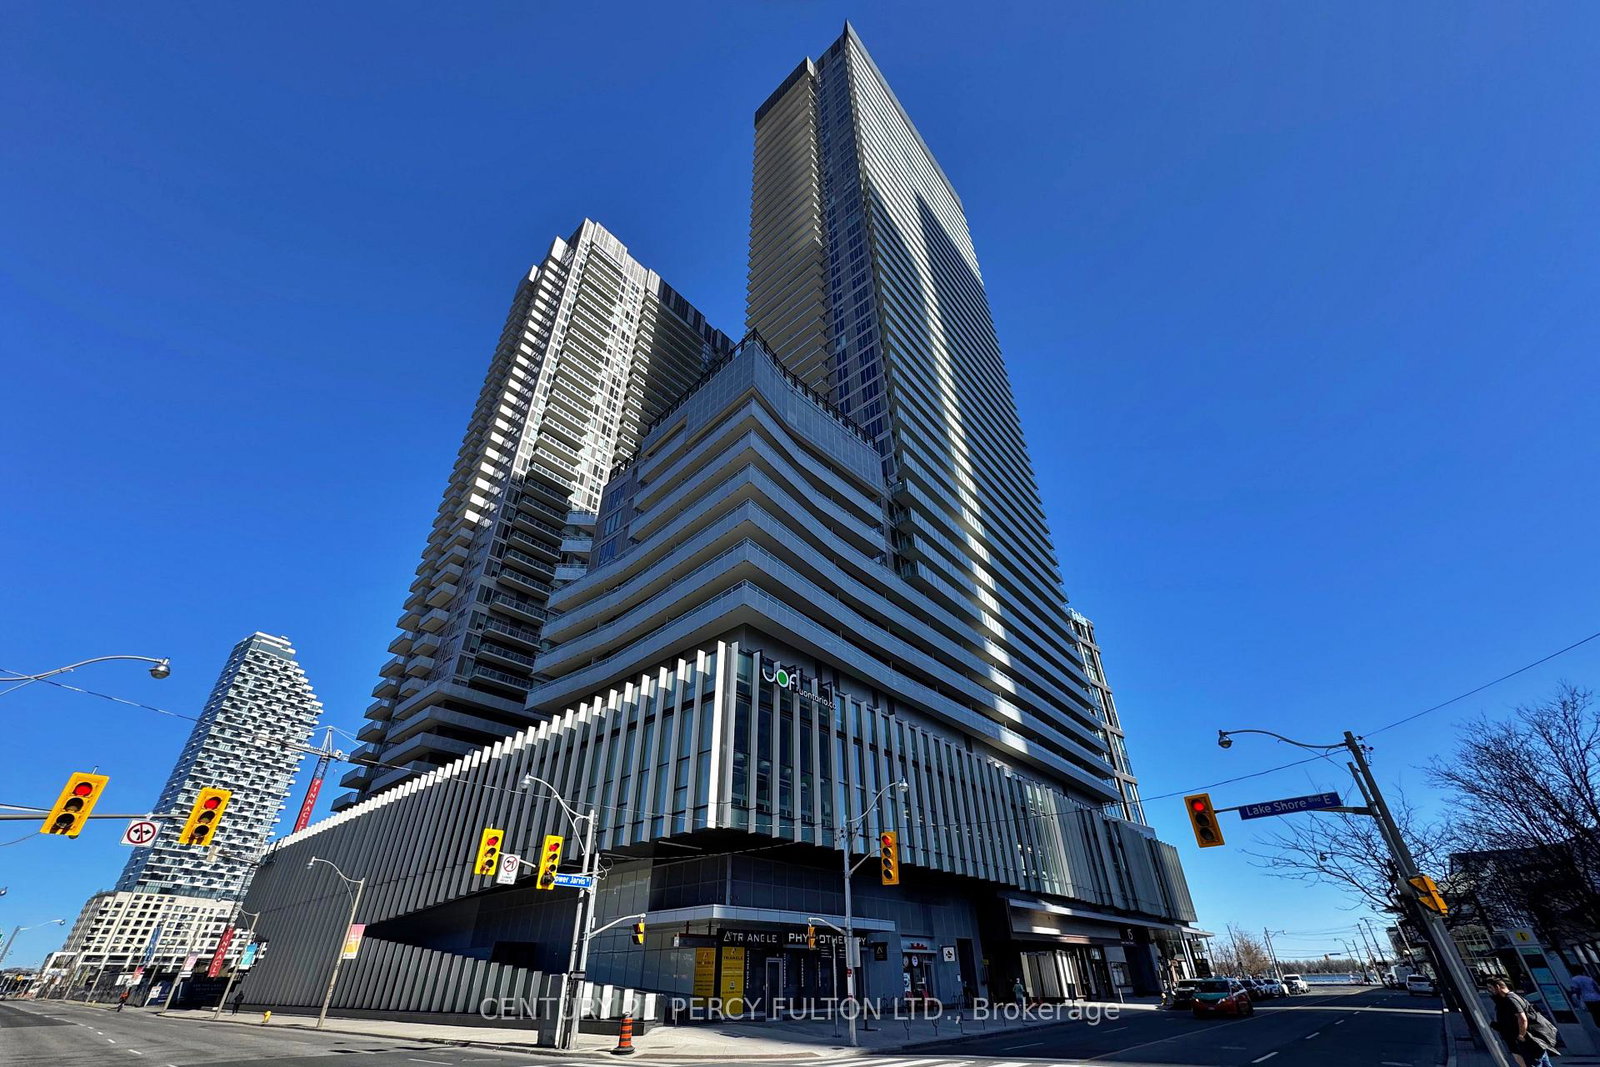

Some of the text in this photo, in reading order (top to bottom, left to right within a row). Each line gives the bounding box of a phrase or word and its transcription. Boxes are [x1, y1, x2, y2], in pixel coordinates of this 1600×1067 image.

[1246, 804, 1272, 816] Lake
[1273, 800, 1306, 812] Shore
[1322, 794, 1332, 805] E
[570, 876, 586, 885] Jarvis
[732, 932, 778, 943] TRANGLE
